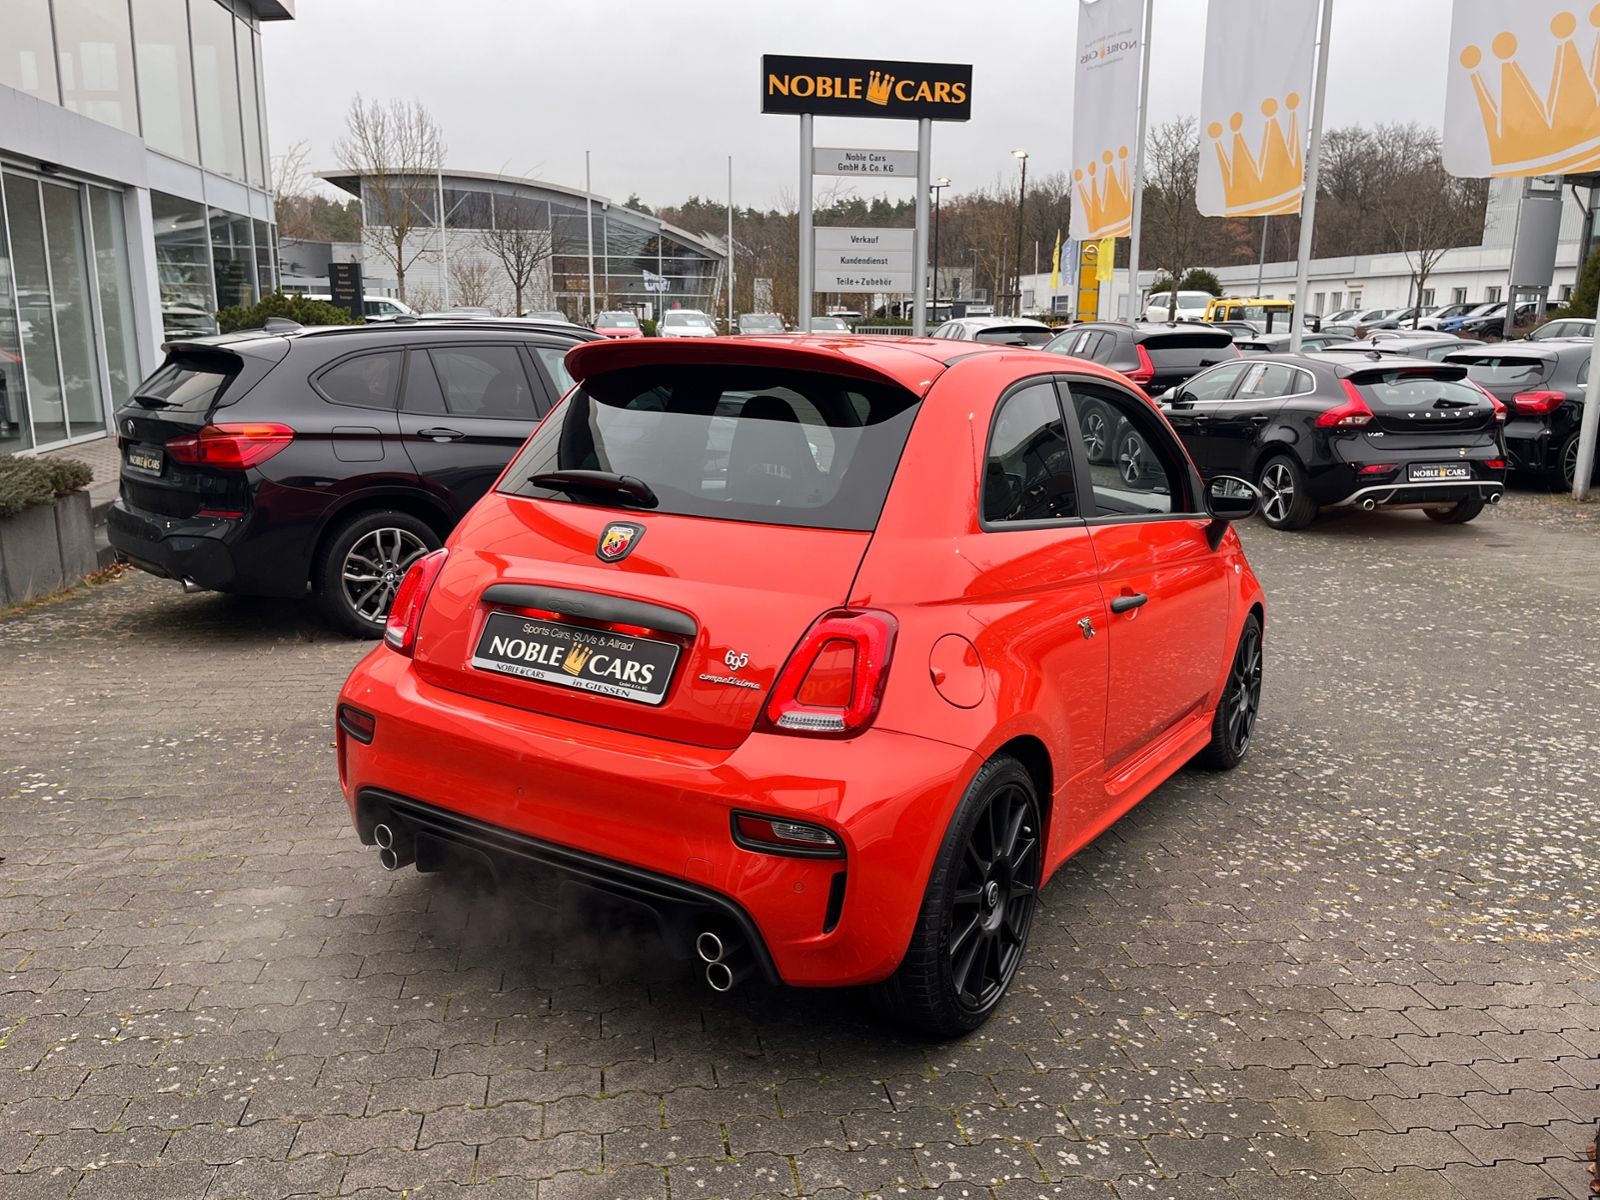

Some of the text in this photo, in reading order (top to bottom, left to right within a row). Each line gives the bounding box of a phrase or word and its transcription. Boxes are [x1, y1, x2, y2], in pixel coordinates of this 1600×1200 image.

[768, 74, 967, 104] NOBLE CARS
[845, 153, 886, 162] Noble Cars
[838, 163, 859, 171] GmbH
[869, 164, 881, 172] Co.
[883, 164, 894, 172] KG
[850, 235, 879, 244] Verkauf
[840, 256, 888, 265] Kundendienst
[1408, 410, 1474, 418] VOLVO
[1413, 469, 1439, 477] NOBLE
[522, 623, 550, 636] Sports
[573, 632, 597, 644] SUVs
[598, 637, 605, 646] &
[607, 638, 634, 652] Allrad
[489, 635, 656, 684] NOBLE CARS
[725, 649, 749, 671] 695
[496, 663, 545, 679] NOBLE CARS
[572, 679, 631, 697] in GIESSEN
[699, 673, 760, 689] competizione
